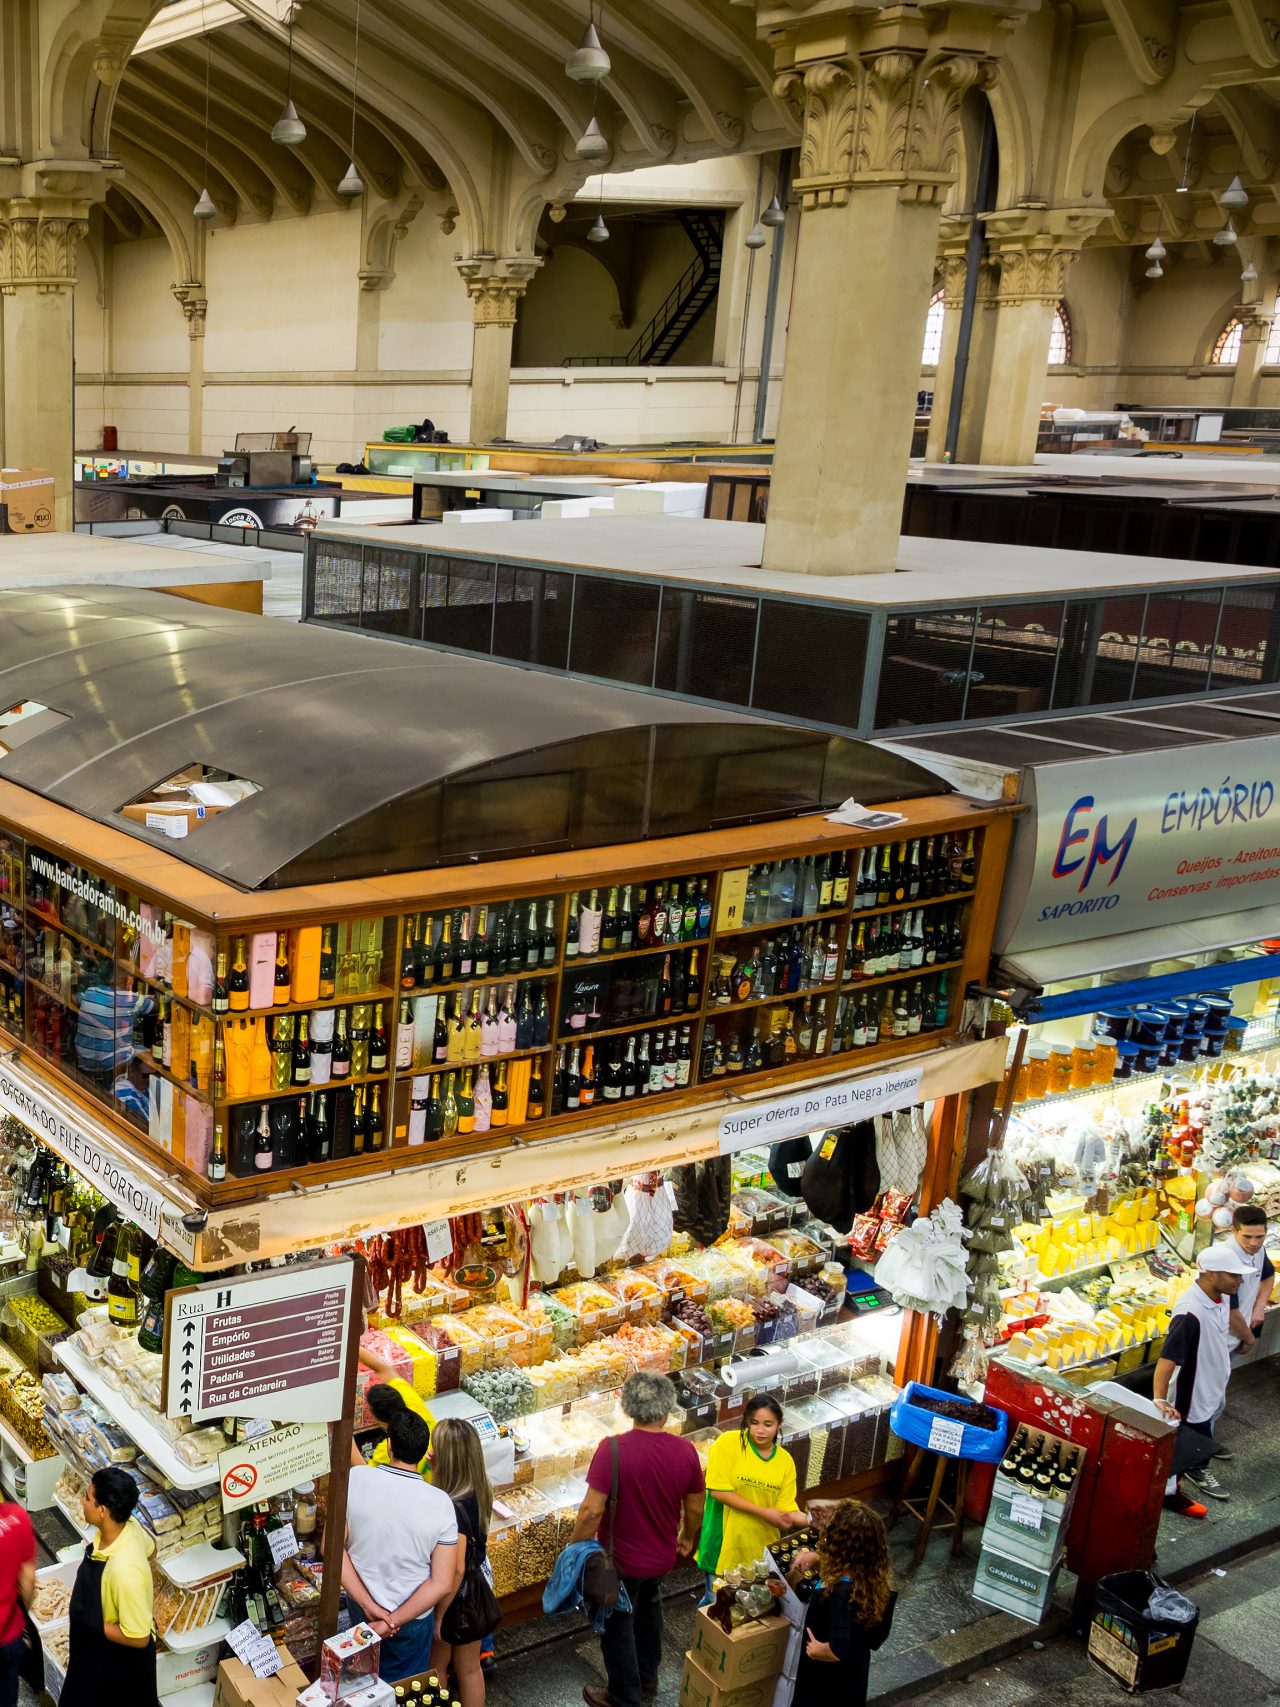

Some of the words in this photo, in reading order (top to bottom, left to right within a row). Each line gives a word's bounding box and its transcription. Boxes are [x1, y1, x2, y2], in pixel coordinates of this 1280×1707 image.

[1161, 776, 1274, 834] EMPÓRIO
[1052, 795, 1137, 893] EM
[1176, 857, 1221, 875] Queijos
[30, 854, 167, 946] www.bancadoramon.com.br
[1147, 881, 1212, 902] Conservas
[1037, 894, 1120, 922] SAPORITO
[723, 1116, 762, 1135] Super
[766, 1105, 799, 1122] Oferta
[805, 1101, 820, 1113] Do
[825, 1093, 848, 1108] Pata
[851, 1086, 882, 1102] Negra
[885, 1077, 918, 1093] Ibérico
[0, 1077, 39, 1121] OFERTA
[40, 1108, 58, 1133] DO
[59, 1125, 81, 1157] FILÉ
[82, 1143, 102, 1174] DO
[102, 1162, 159, 1226] PORTO!!!
[177, 1301, 205, 1317] Rua
[217, 1290, 232, 1309] H
[325, 1292, 340, 1300] Fruits
[213, 1314, 242, 1328] Frutas
[305, 1313, 324, 1322] Grocery
[325, 1310, 338, 1318] Store
[211, 1330, 251, 1348] Empório
[321, 1329, 337, 1337] Utility
[211, 1348, 256, 1367] Utilidades
[318, 1348, 335, 1356] Bakery
[210, 1369, 244, 1385] Padaria
[209, 1392, 227, 1405] Rua
[229, 1388, 241, 1400] da
[242, 1378, 287, 1397] Cantareira
[268, 1450, 288, 1461] MOTIVO
[297, 1458, 323, 1472] MERCADO
[263, 1469, 281, 1479] ANDAR
[289, 1456, 316, 1469] BICICLETA
[989, 1565, 1019, 1583] GRANDI
[1020, 1577, 1038, 1590] VINI
